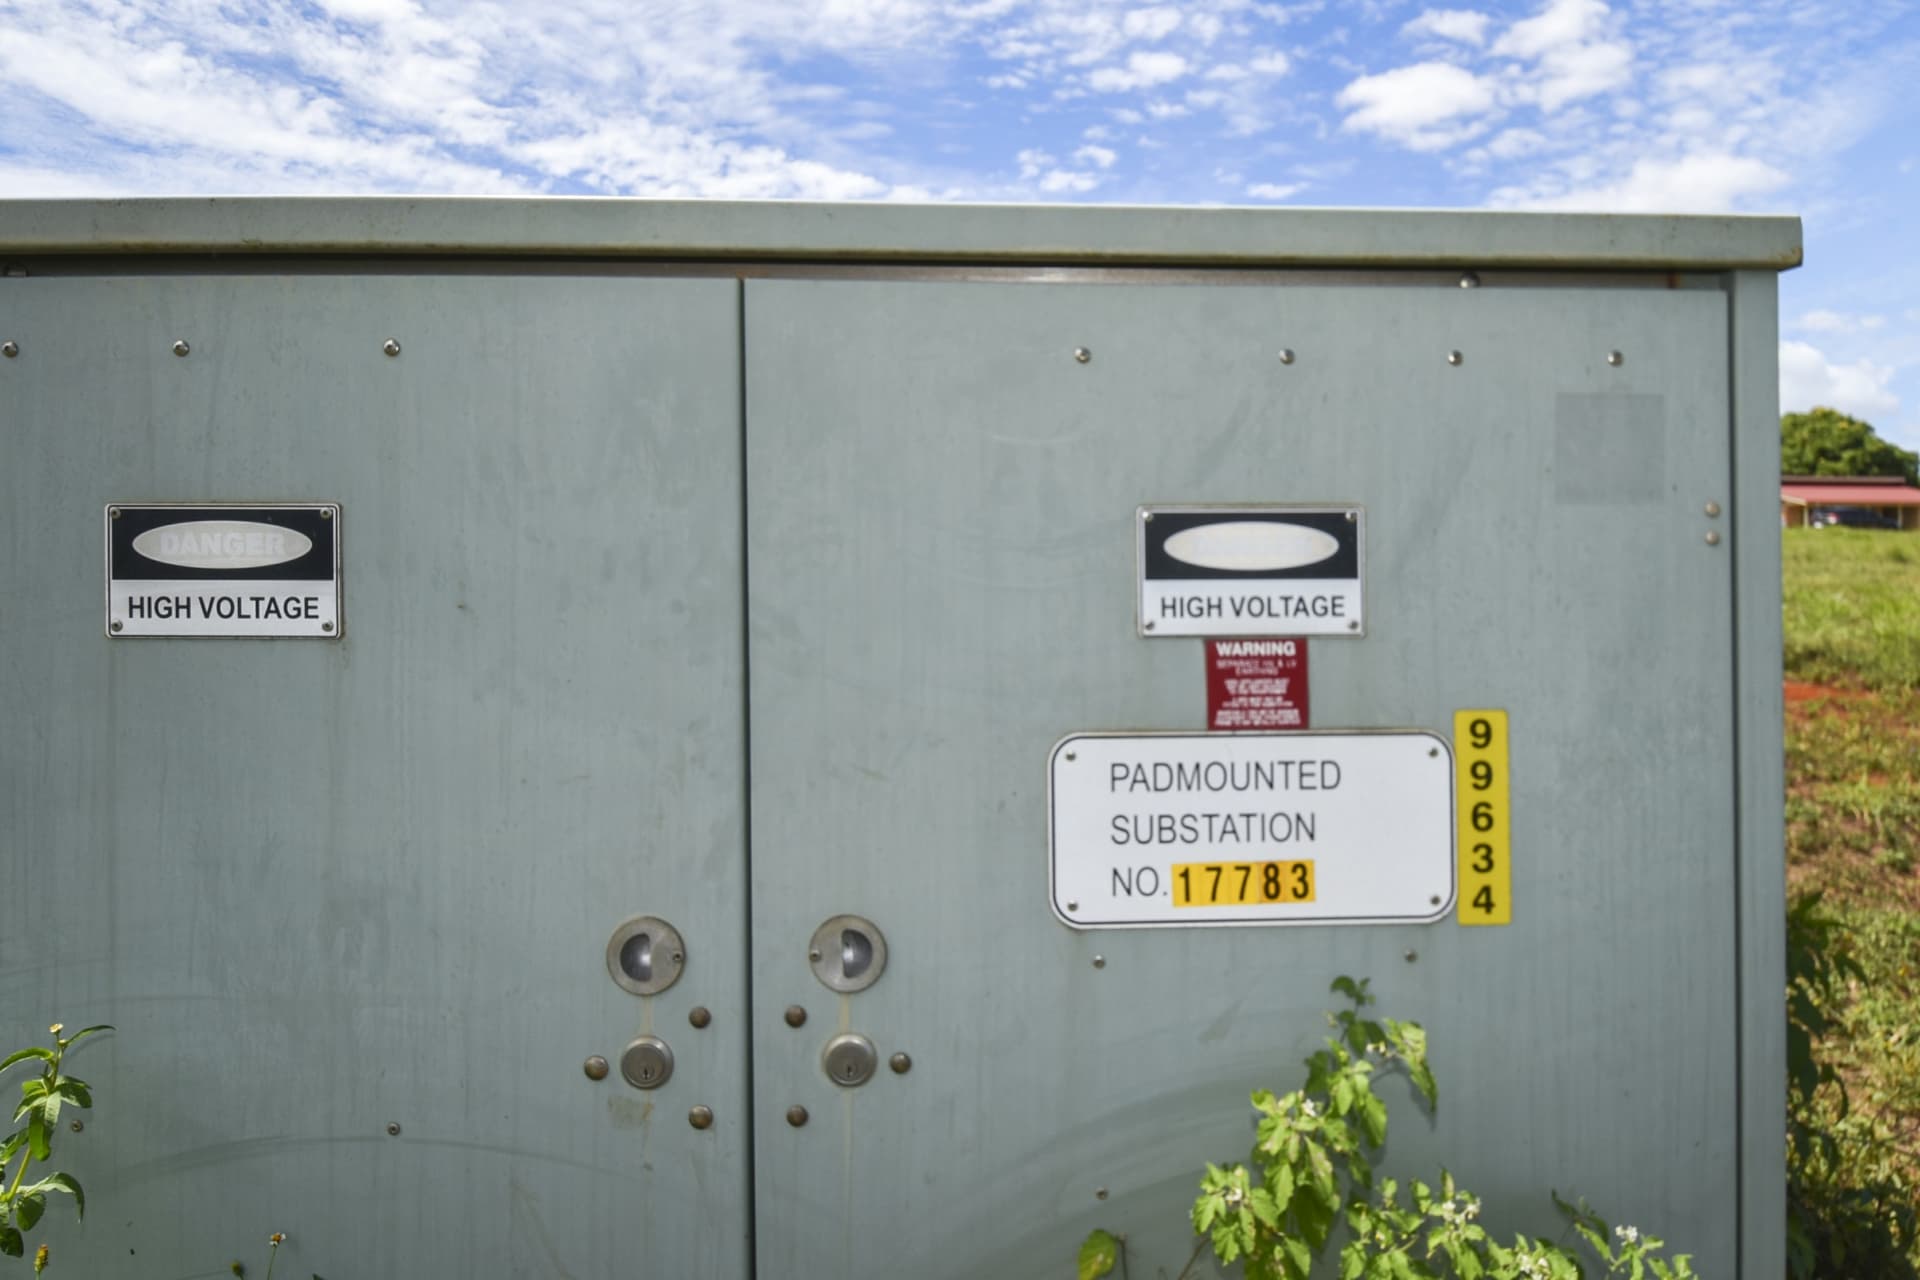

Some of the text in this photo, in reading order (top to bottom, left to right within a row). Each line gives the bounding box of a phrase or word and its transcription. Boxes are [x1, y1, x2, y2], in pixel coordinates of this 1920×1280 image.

[159, 532, 286, 556] DANGER
[128, 596, 319, 619] HIGH VOLTAGE
[1161, 596, 1345, 618] HIGH VOLTAGE
[1215, 640, 1296, 656] WARNING
[1110, 760, 1342, 792] PADMOUNTED
[1111, 813, 1316, 845] SUBSTATION
[1111, 862, 1311, 903] NO. 17783
